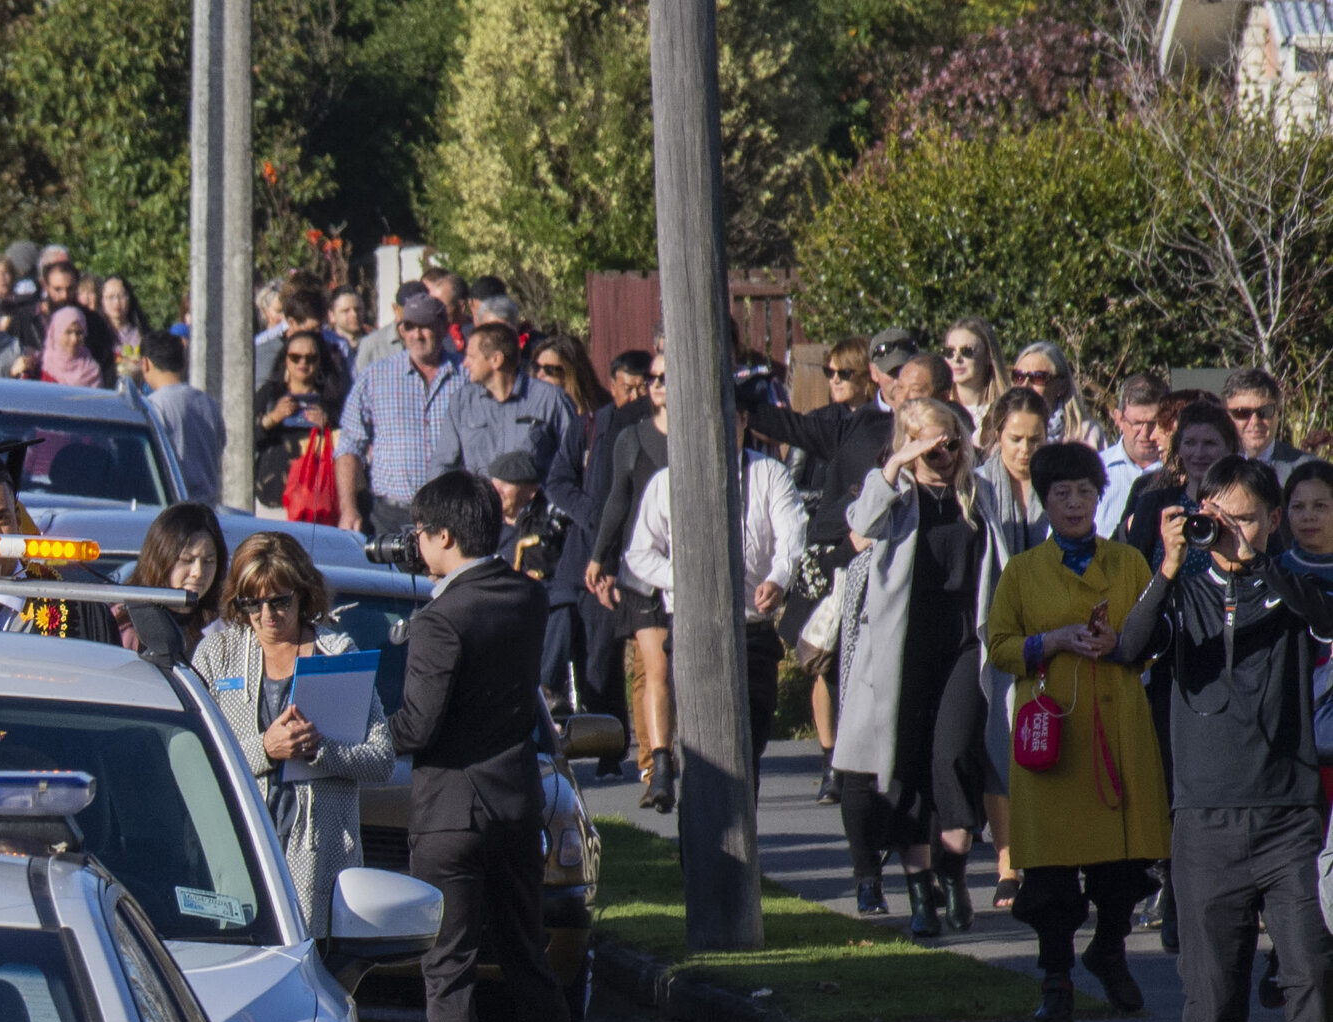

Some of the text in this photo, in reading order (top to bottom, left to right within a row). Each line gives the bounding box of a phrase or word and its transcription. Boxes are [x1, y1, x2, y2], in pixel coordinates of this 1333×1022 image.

[1032, 712, 1043, 752] FOR EVER
[1040, 711, 1049, 751] MAKE UP
